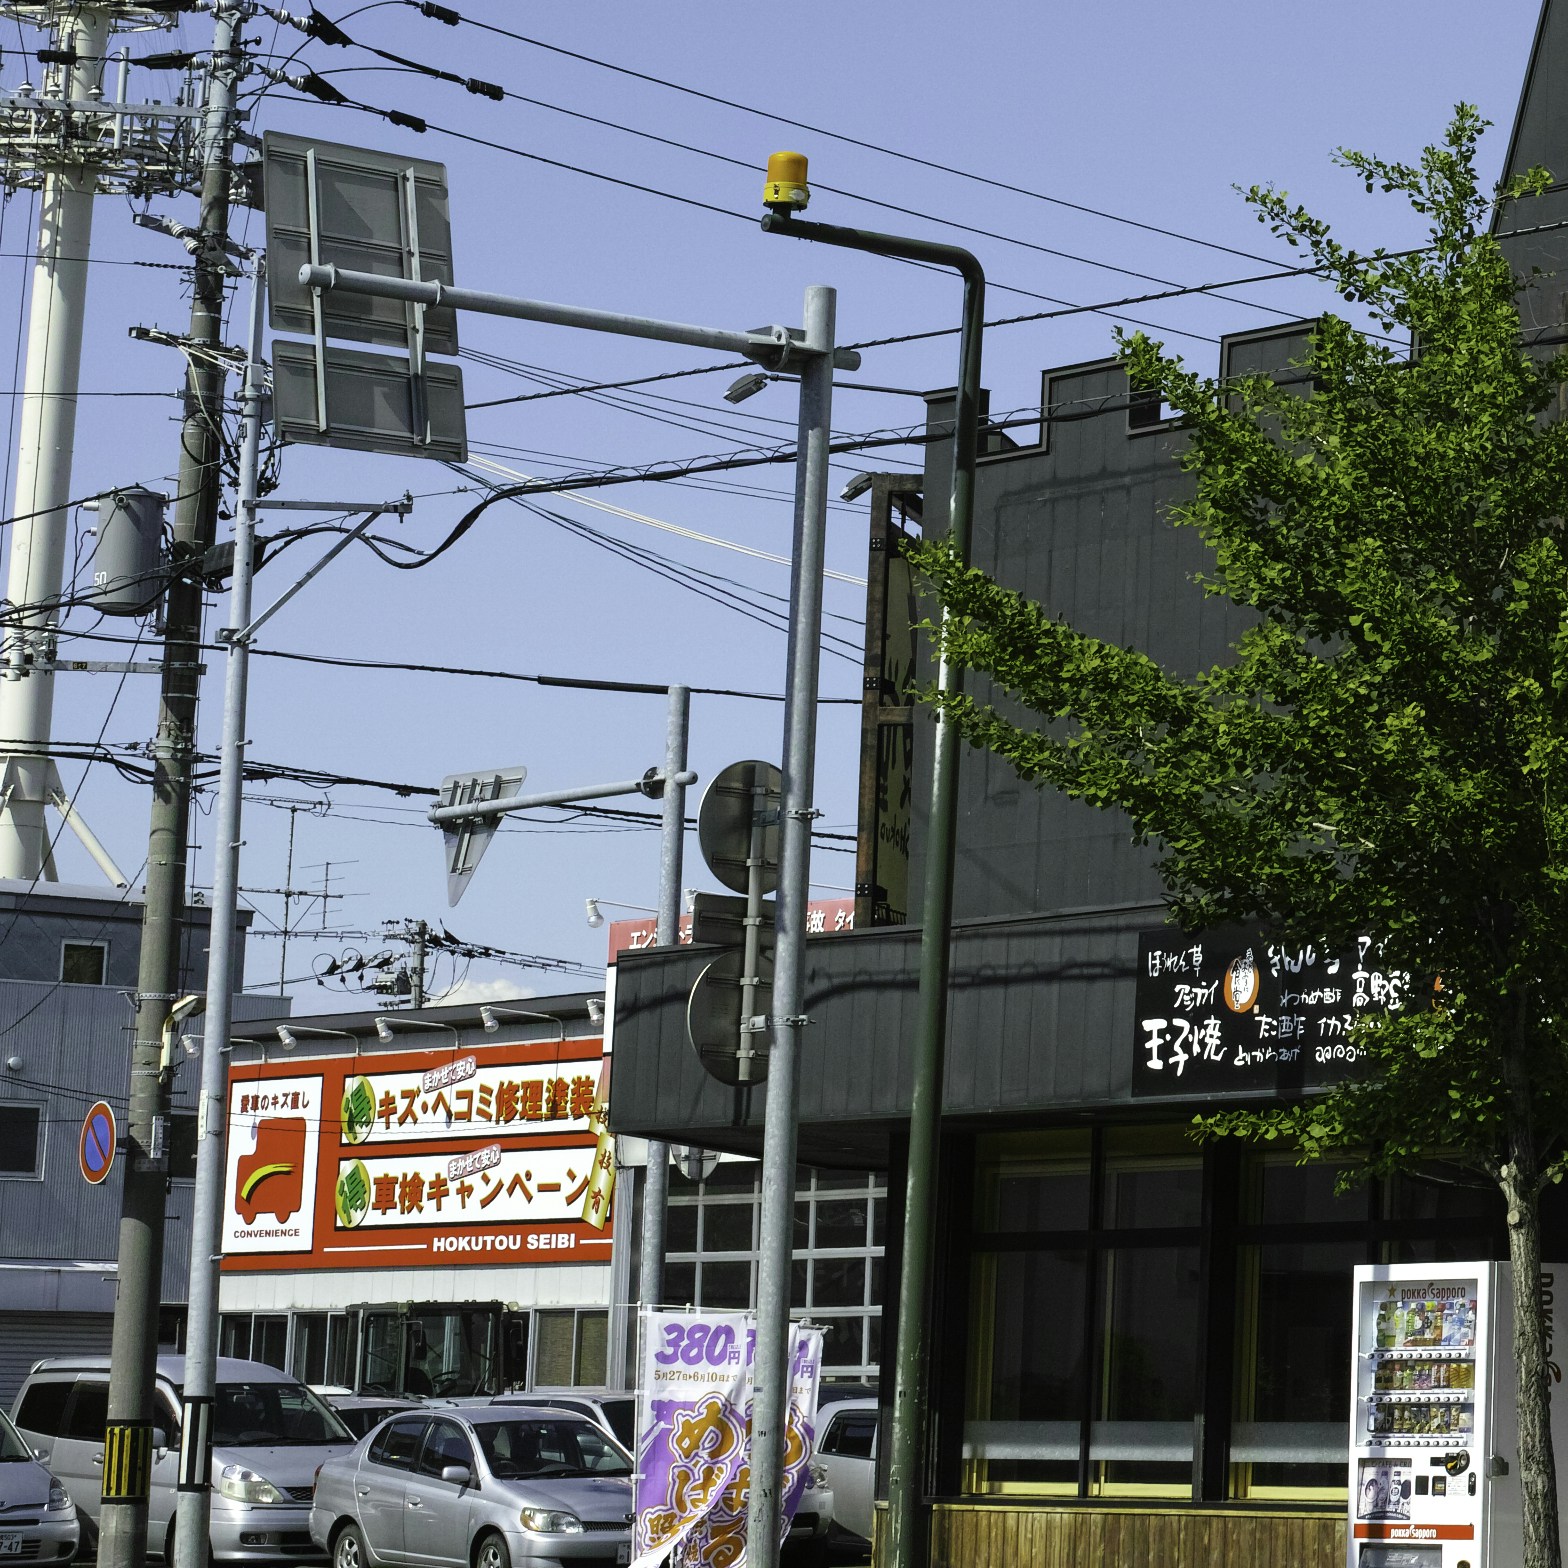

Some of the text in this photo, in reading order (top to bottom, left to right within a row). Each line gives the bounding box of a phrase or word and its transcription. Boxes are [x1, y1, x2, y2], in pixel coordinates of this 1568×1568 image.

[1149, 944, 1204, 978] ほうれん草
[1173, 979, 1220, 1010] アジフライ
[1142, 1015, 1228, 1078] 玉子焼
[424, 1058, 476, 1088] まかせて安心
[240, 1091, 310, 1113] 愛車のキズ直し
[449, 1147, 500, 1178] まかせて安心
[372, 1167, 590, 1216] 車検キャンペーン
[233, 1228, 300, 1238] CONVENIENCE
[432, 1233, 576, 1252] HOKUTOU SEIBI
